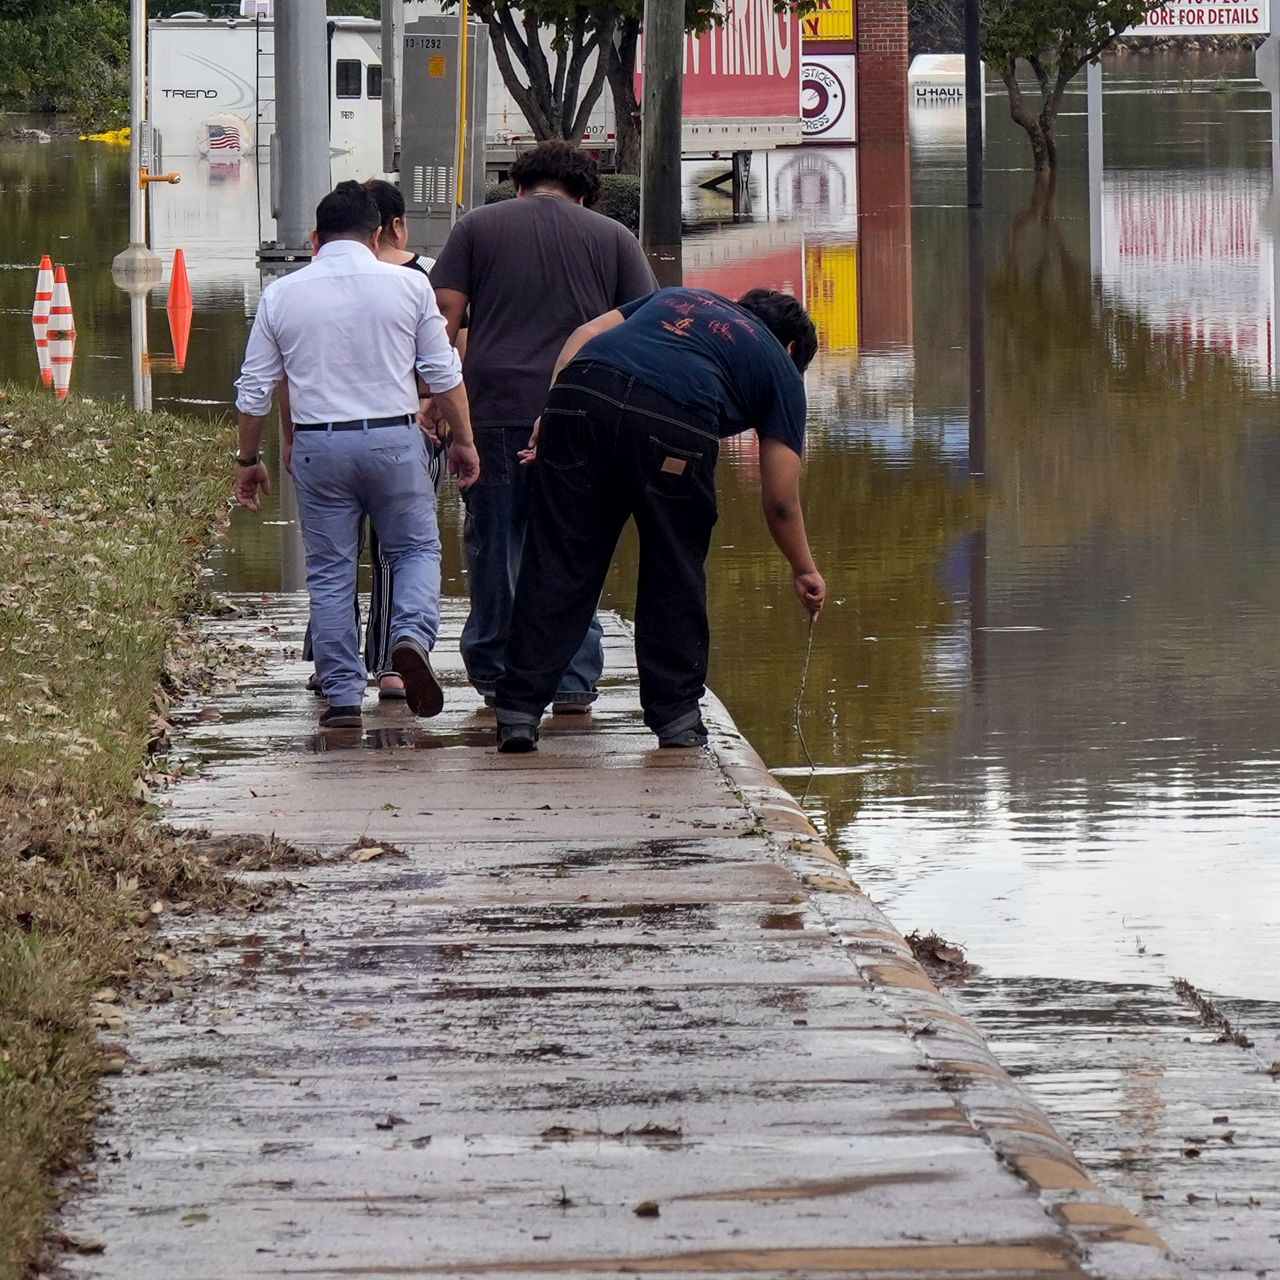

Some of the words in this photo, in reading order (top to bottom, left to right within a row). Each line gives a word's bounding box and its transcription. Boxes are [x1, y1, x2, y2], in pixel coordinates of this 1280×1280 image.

[1144, 10, 1175, 26] TORE
[1179, 10, 1206, 26] FOR
[1209, 8, 1259, 25] DETAILS
[405, 38, 442, 49] 13-1292
[801, 68, 835, 88] STICKS
[161, 89, 218, 99] TREND
[916, 88, 963, 97] U-HAUL
[800, 114, 830, 130] PRESS
